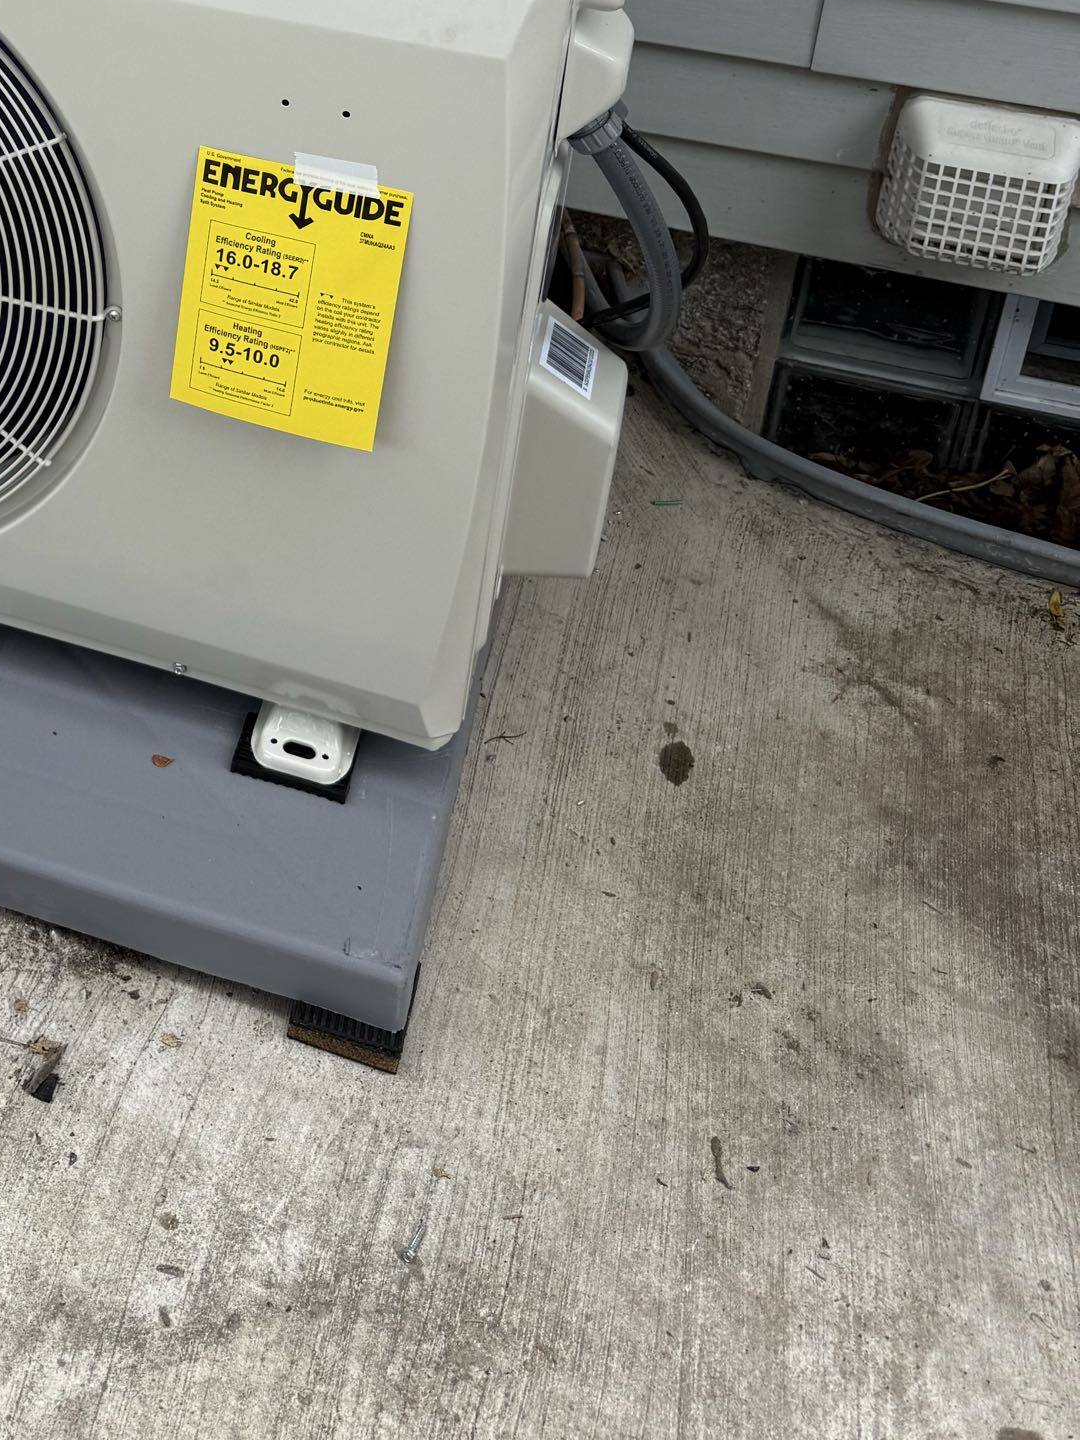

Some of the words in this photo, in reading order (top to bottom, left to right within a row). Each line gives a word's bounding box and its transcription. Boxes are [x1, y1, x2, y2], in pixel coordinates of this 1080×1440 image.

[216, 152, 242, 163] Government
[200, 192, 217, 202] Cooling
[215, 235, 254, 252] Efficiency
[256, 245, 282, 259] Rating
[245, 232, 276, 247] Cooling
[216, 248, 299, 279] 16.0-18.7
[226, 294, 241, 304] Range
[264, 304, 280, 312] Models
[317, 299, 341, 309] efficiency
[342, 305, 359, 313] ratings
[360, 308, 380, 317] depend
[314, 318, 333, 328] heating
[334, 322, 358, 333] efficiency
[355, 314, 381, 323] contractor
[204, 324, 242, 342] Efficiency
[243, 334, 269, 349] Rating
[232, 322, 263, 338] Heating
[312, 331, 341, 341] geographic
[324, 340, 349, 349] contractor
[209, 337, 280, 368] 9.5-10.0
[215, 382, 230, 391] Range
[313, 391, 331, 400] energy
